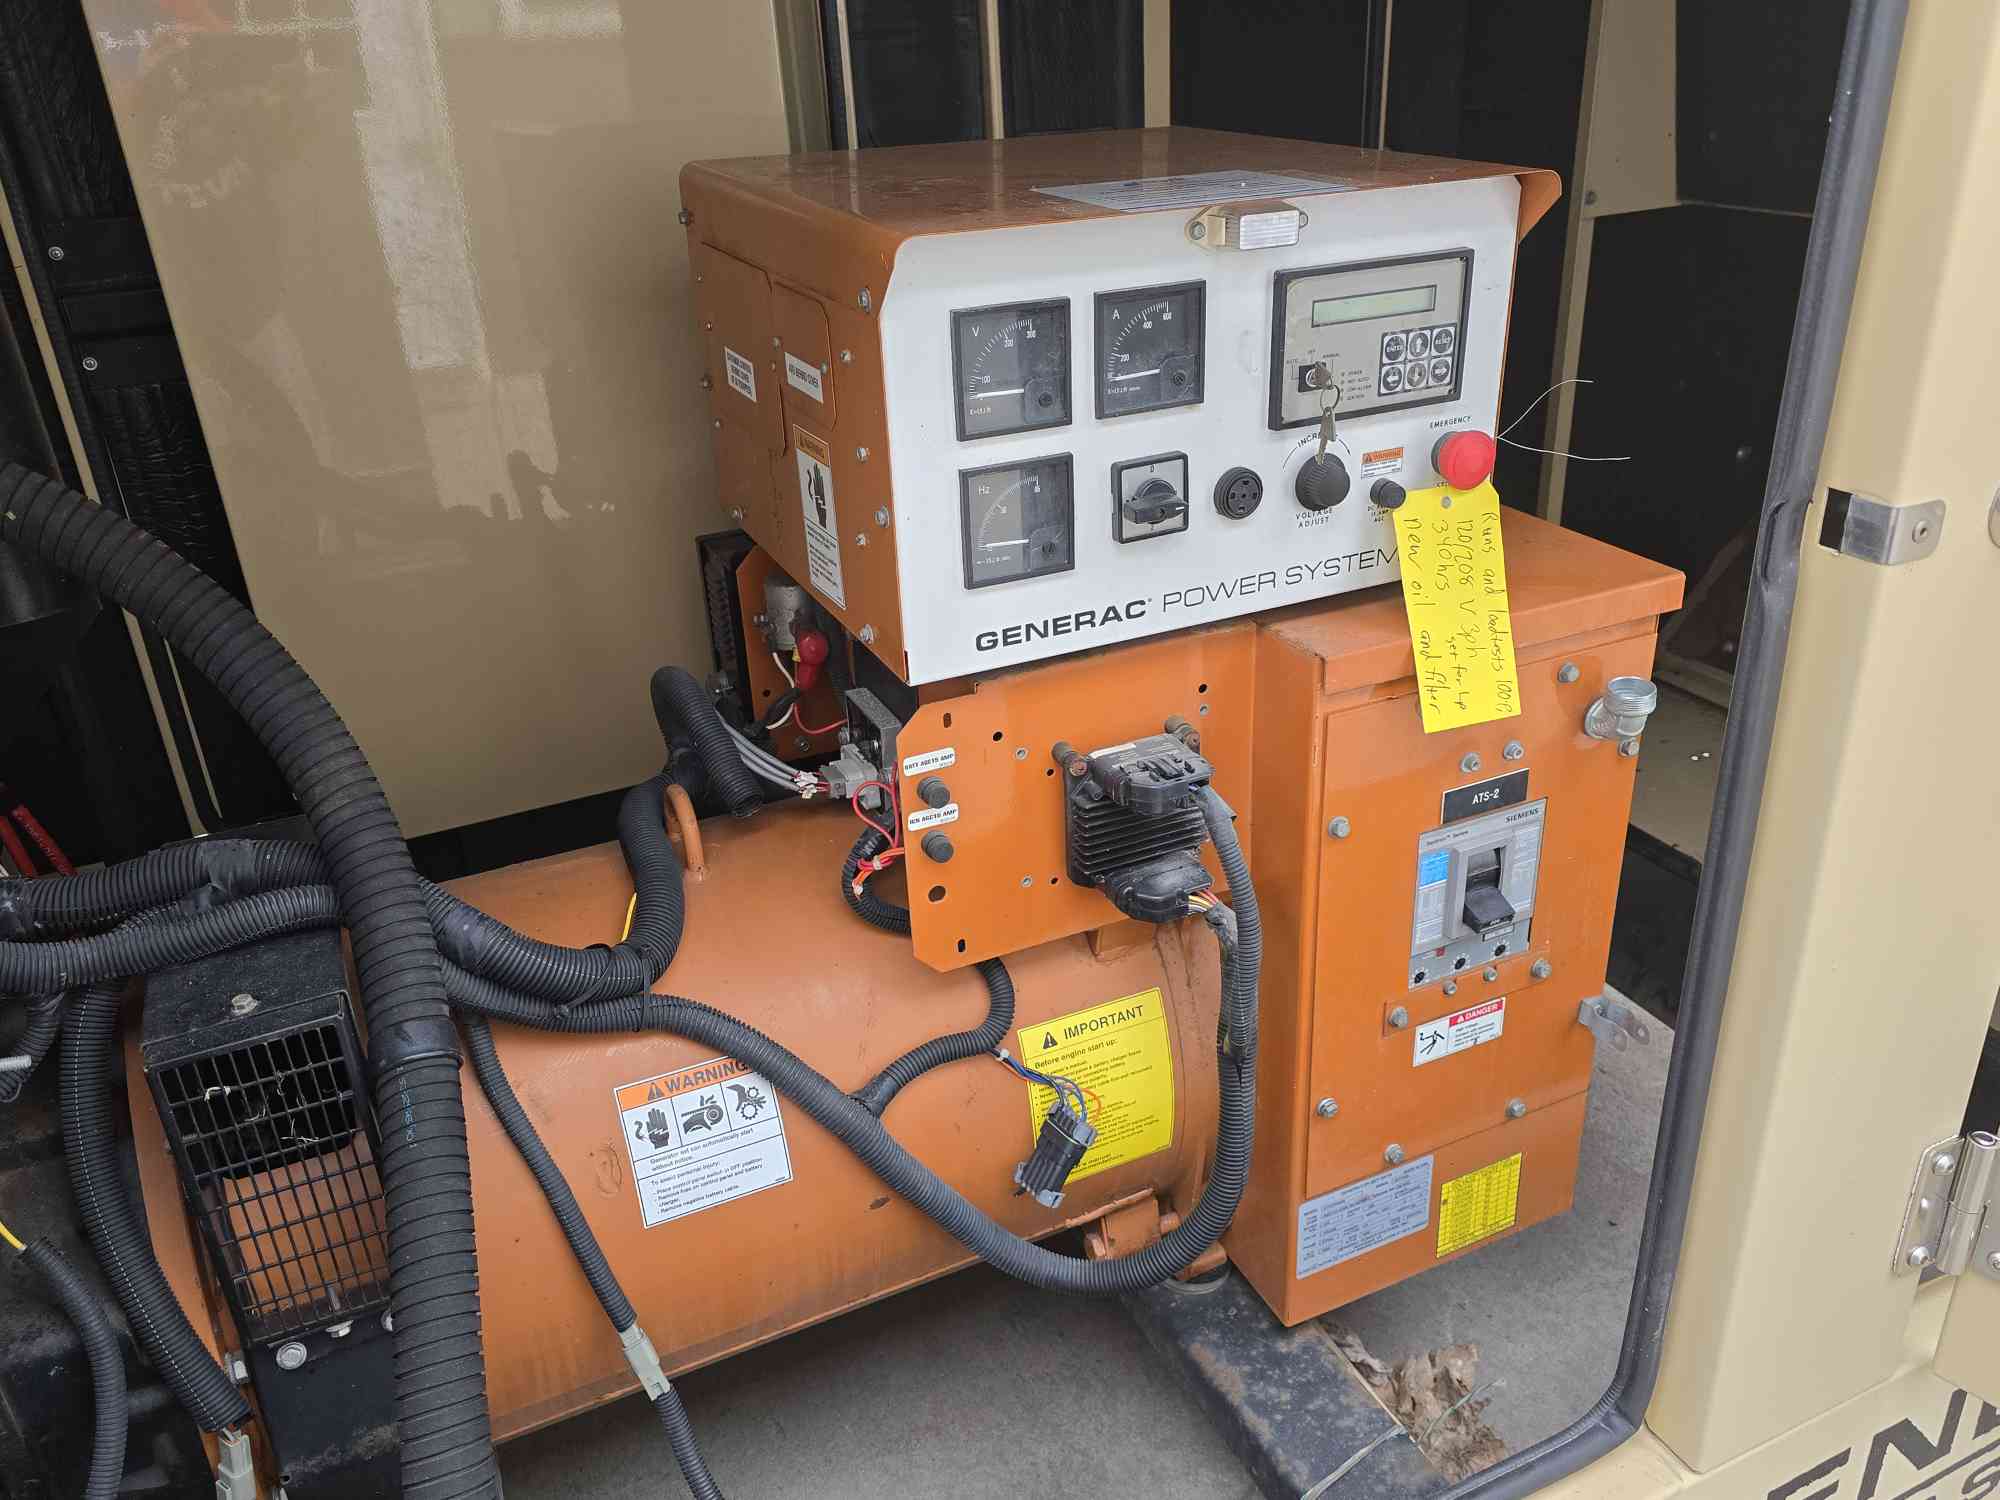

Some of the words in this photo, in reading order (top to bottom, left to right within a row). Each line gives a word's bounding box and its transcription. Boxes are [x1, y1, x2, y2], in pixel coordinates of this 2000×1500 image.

[1112, 309, 1121, 320] A
[971, 325, 981, 337] V
[1430, 416, 1471, 429] EMERGENCY
[978, 485, 992, 496] Hz
[1295, 507, 1333, 520] VOLTAGE
[1298, 517, 1330, 528] ADJUST
[1481, 512, 1499, 553] Runs
[1454, 520, 1475, 588] 120/208
[1483, 568, 1505, 594] and
[1410, 580, 1437, 607] oil
[975, 599, 1148, 652] GENERAC
[1162, 570, 1277, 613] POWER
[1459, 598, 1478, 616] V
[1420, 630, 1443, 660] and
[1446, 636, 1459, 661] set
[1449, 663, 1469, 686] for
[1423, 665, 1452, 716] filter
[940, 753, 954, 761] AMP
[1472, 788, 1500, 805] ATS-2
[943, 808, 957, 816] AMP
[1505, 808, 1539, 823] SIEMENS
[1464, 1004, 1498, 1019] DANGER
[1064, 1005, 1144, 1040] IMPORTANT
[1034, 1056, 1060, 1070] Before
[1060, 1047, 1087, 1064] engine
[1087, 1041, 1104, 1054] start
[1106, 1038, 1119, 1050] up:
[664, 1060, 749, 1092] WARNING
